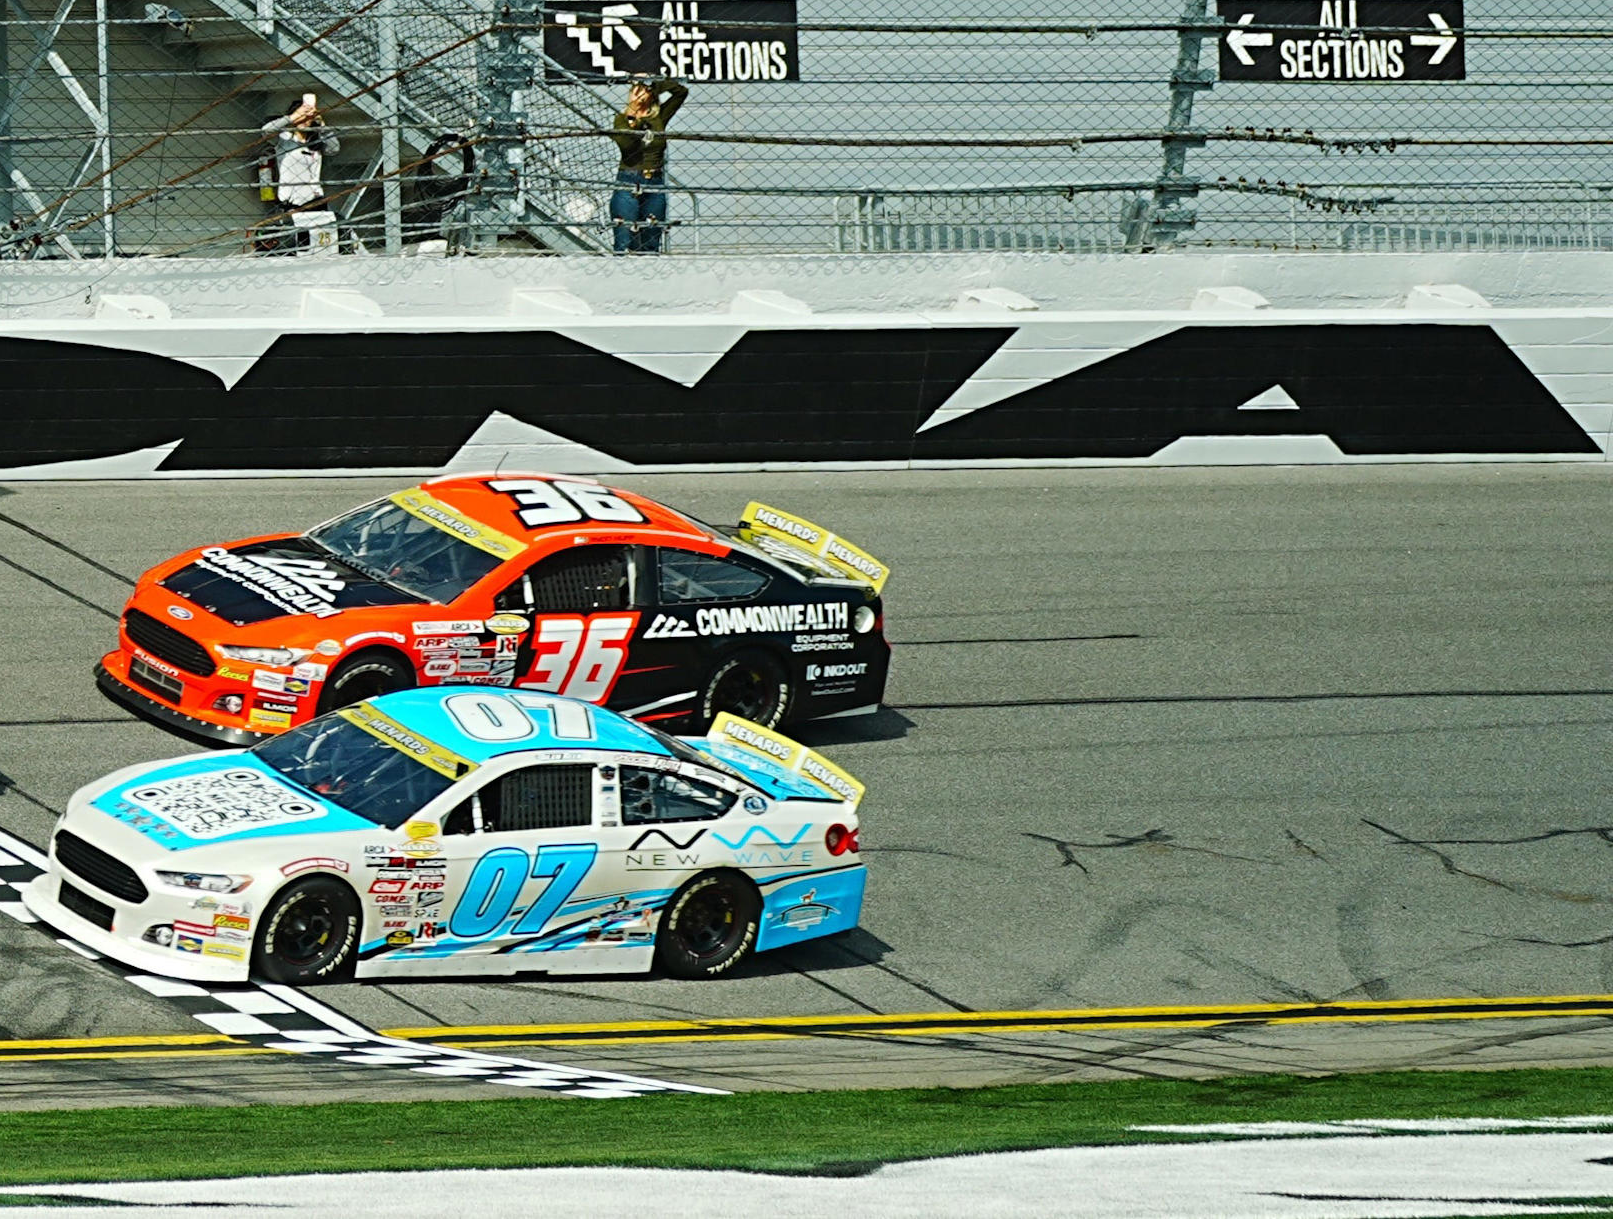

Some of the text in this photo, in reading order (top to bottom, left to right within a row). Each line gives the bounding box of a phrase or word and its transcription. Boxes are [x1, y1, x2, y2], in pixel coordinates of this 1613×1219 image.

[660, 2, 707, 41] ALL
[1319, 0, 1358, 40] ALL
[659, 42, 788, 82] SECTIONS
[1280, 39, 1405, 80] SECTIONS
[419, 504, 479, 540] MENARDS
[488, 479, 646, 527] 36
[755, 507, 821, 545] MENARDS
[828, 541, 883, 581] MENARDS
[201, 546, 344, 619] COMMONWEALTH
[450, 622, 472, 632] ARCA
[695, 601, 850, 636] COMMONWEALTH
[795, 633, 851, 644] EQUIPMENT
[134, 648, 180, 677] FUSION
[415, 638, 447, 648] ARP
[519, 616, 635, 702] 36
[791, 642, 855, 653] CORPORATION
[365, 716, 430, 756] MENARDS
[443, 692, 596, 741] 07
[724, 720, 792, 760] MENARDS
[803, 757, 859, 802] MENARDS
[364, 844, 386, 855] ARCA
[625, 849, 815, 866] NEW WAVE
[410, 881, 445, 891] ARP
[450, 842, 598, 938] 07
[316, 914, 358, 978] GENERAL
[706, 920, 757, 975] GENERAL
